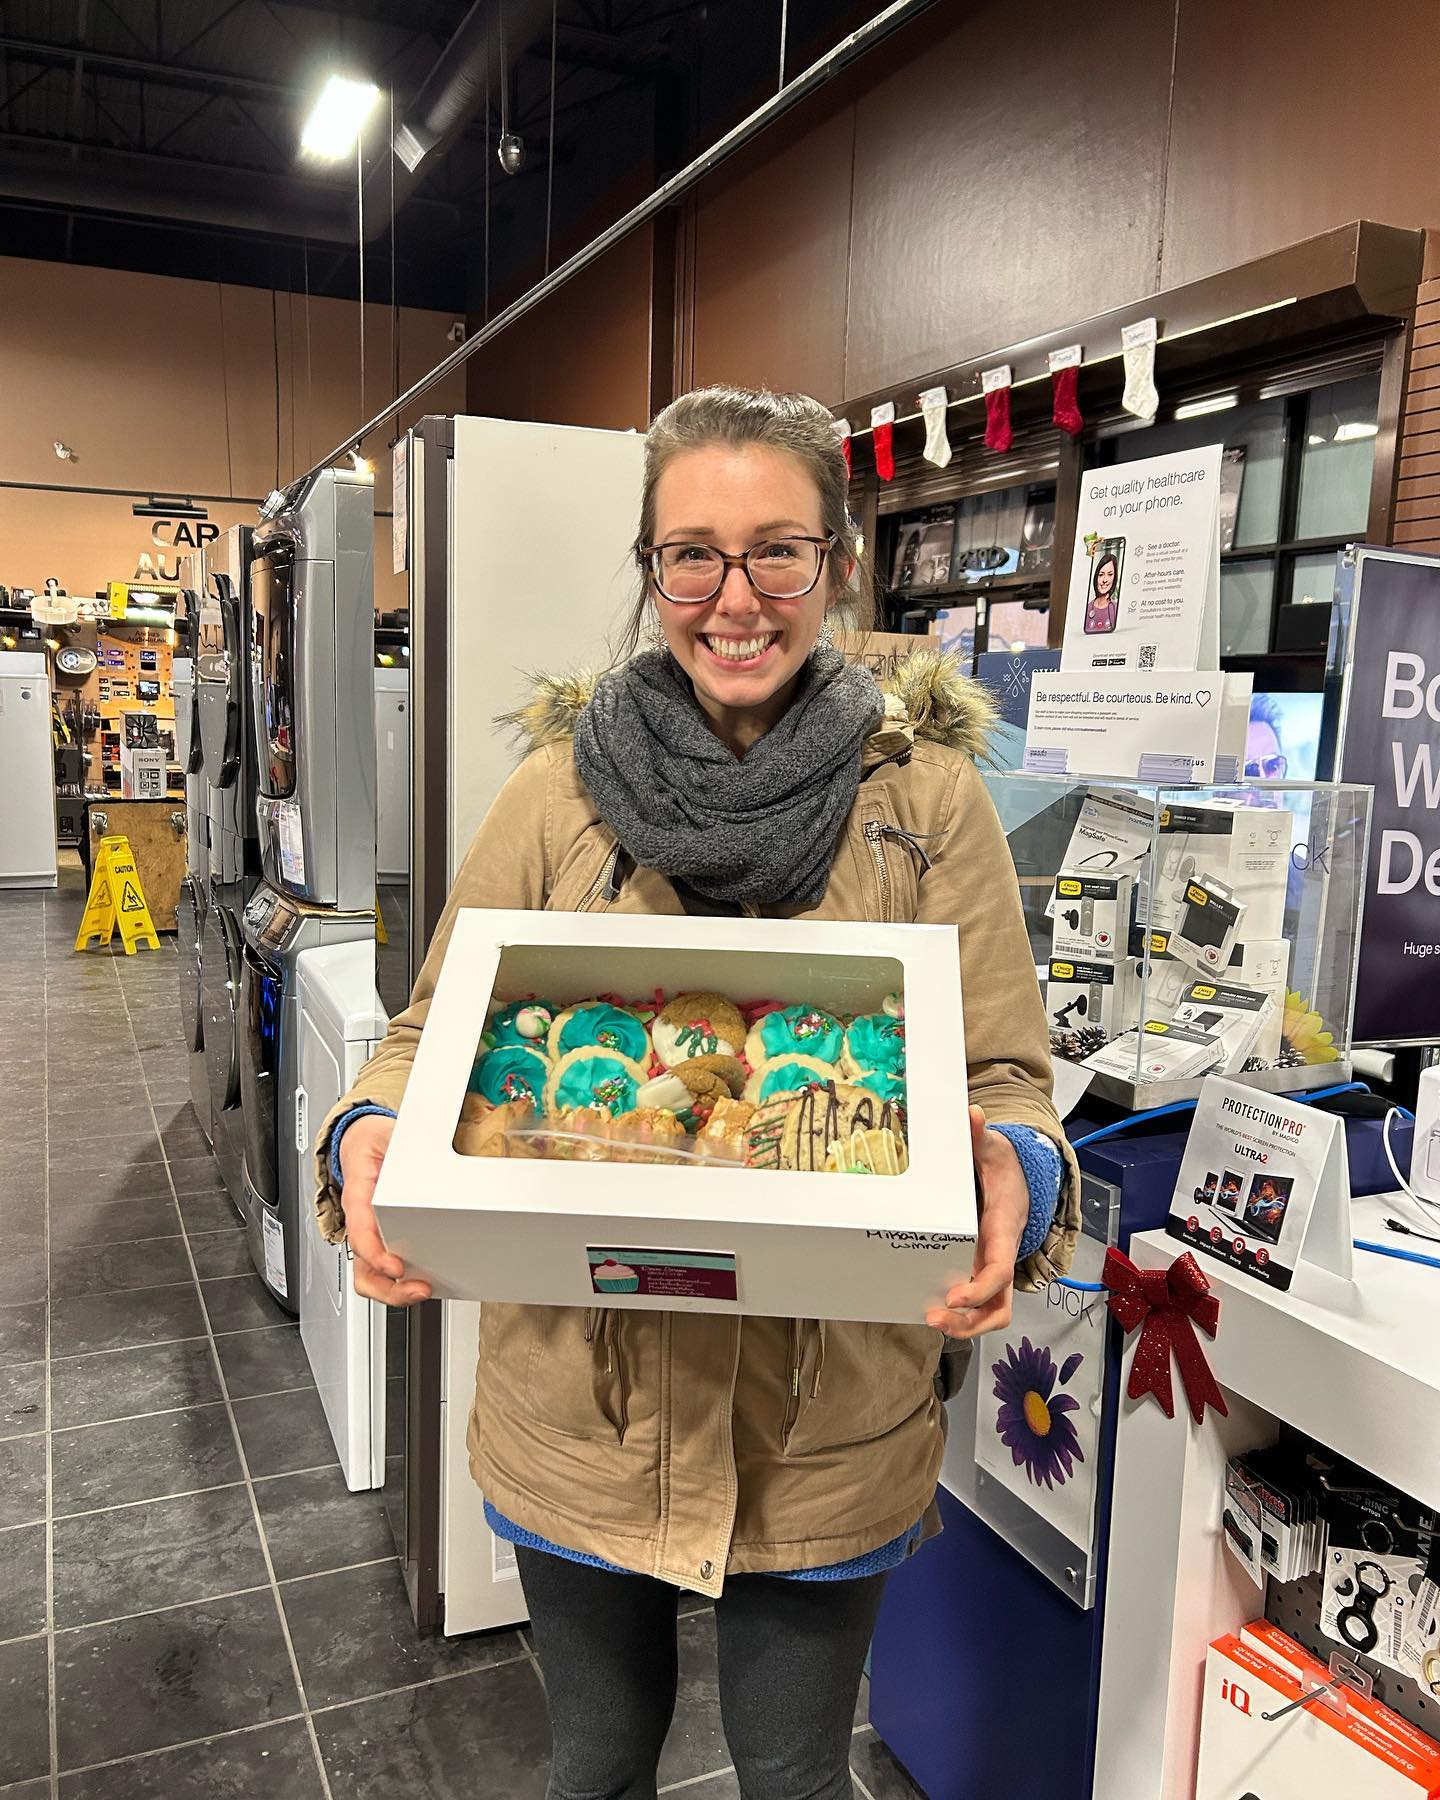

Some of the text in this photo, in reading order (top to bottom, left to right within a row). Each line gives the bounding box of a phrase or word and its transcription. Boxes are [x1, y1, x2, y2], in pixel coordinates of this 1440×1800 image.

[1090, 469, 1206, 500] Get quality healthcare
[1104, 494, 1183, 517] on your phone.
[151, 521, 220, 548] CAR
[134, 552, 190, 581] AU
[1036, 692, 1193, 705] Be respectful. Be courteous. Be kind.
[1079, 828, 1105, 842] MagSafe
[114, 865, 134, 874] CAUTION
[1403, 942, 1433, 958] Huge
[1253, 1136, 1269, 1147] SCREEN
[1268, 1142, 1296, 1157] PROTECTION
[1279, 1133, 1299, 1144] MADICO
[1364, 1498, 1389, 1514] RING
[1282, 1645, 1294, 1654] Pad
[1232, 1649, 1264, 1670] Mouse Pad
[1221, 1678, 1252, 1717] iQ
